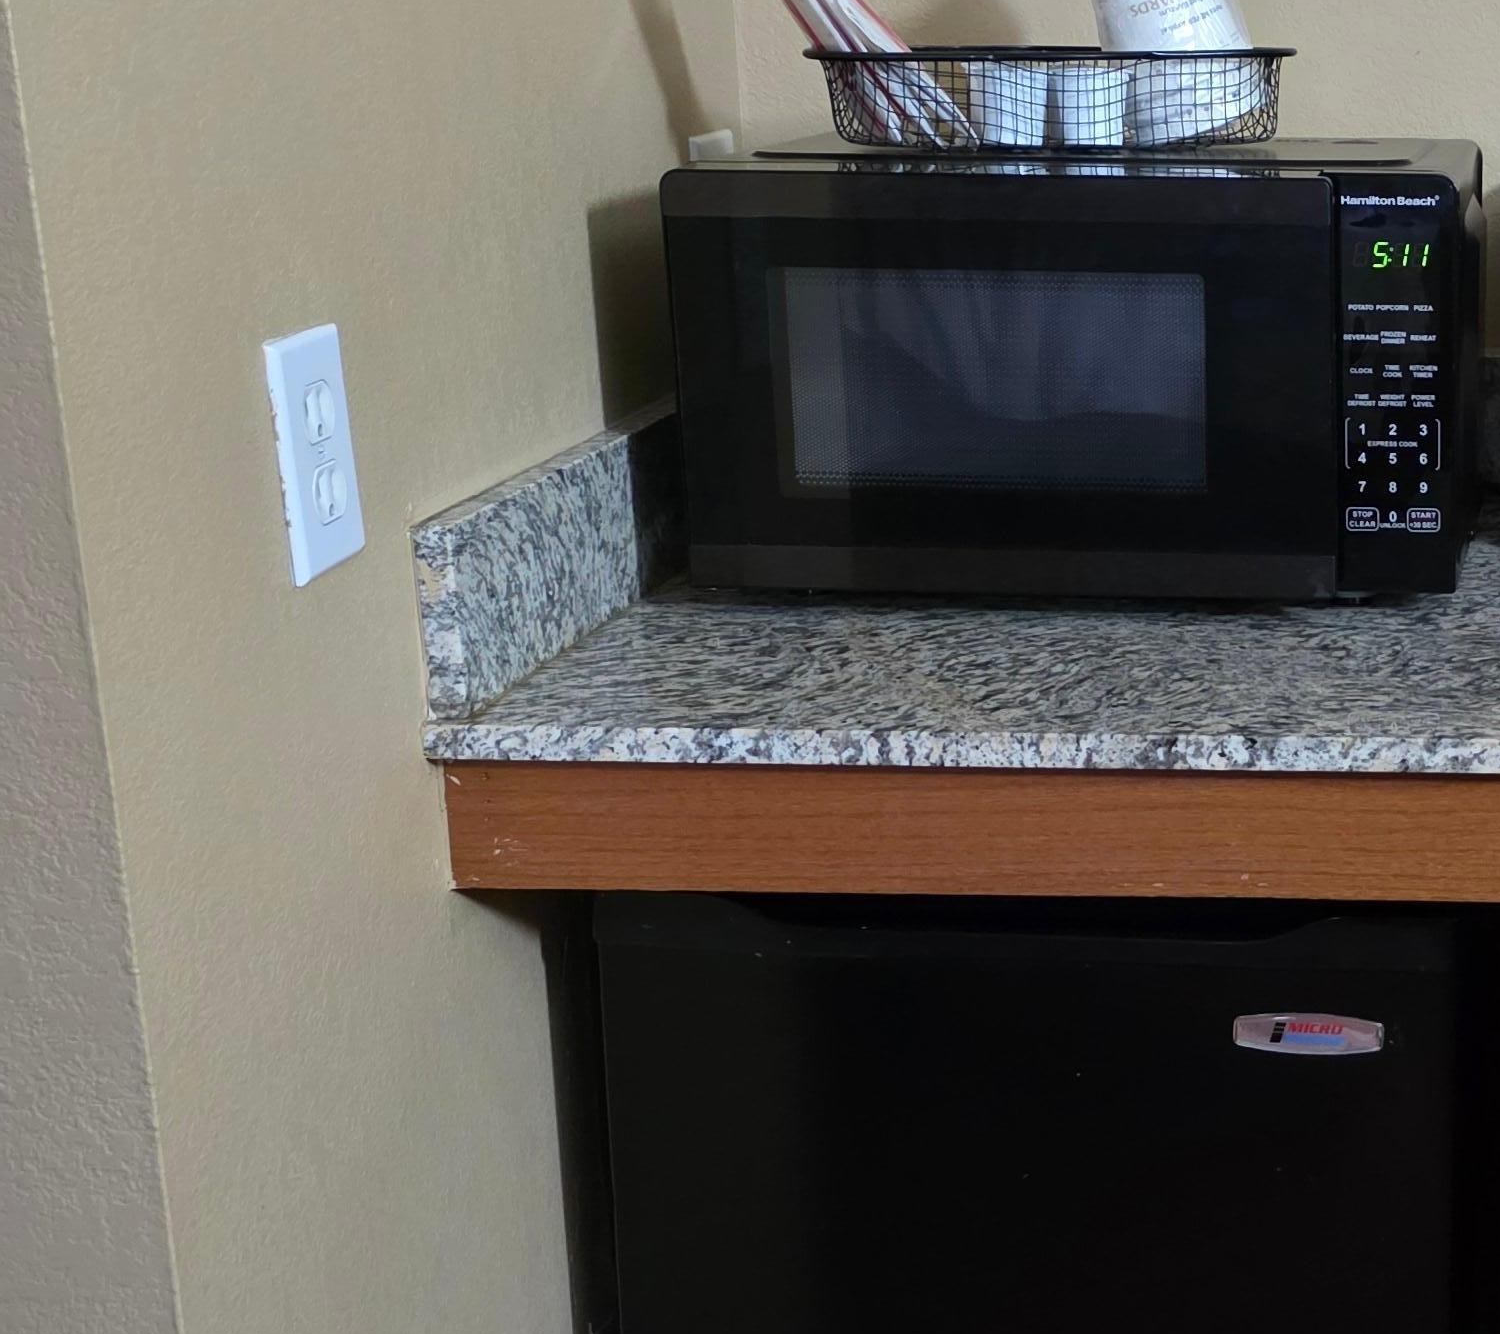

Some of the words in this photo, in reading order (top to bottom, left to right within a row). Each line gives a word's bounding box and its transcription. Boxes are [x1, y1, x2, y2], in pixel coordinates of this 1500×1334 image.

[1340, 195, 1396, 207] Hamilton
[1373, 241, 1430, 268] 5:11
[1358, 423, 1366, 436] 1
[1388, 423, 1397, 436] 2
[1419, 424, 1428, 436] 3
[1357, 452, 1367, 464] 4
[1388, 452, 1397, 465] 5
[1419, 453, 1428, 465] 6
[1357, 480, 1367, 493] 7
[1388, 481, 1397, 493] 8
[1419, 482, 1428, 494] 9
[1352, 510, 1374, 518] STOP
[1388, 510, 1397, 523] 0
[1411, 511, 1437, 519] START
[1349, 520, 1376, 528] CLEAR
